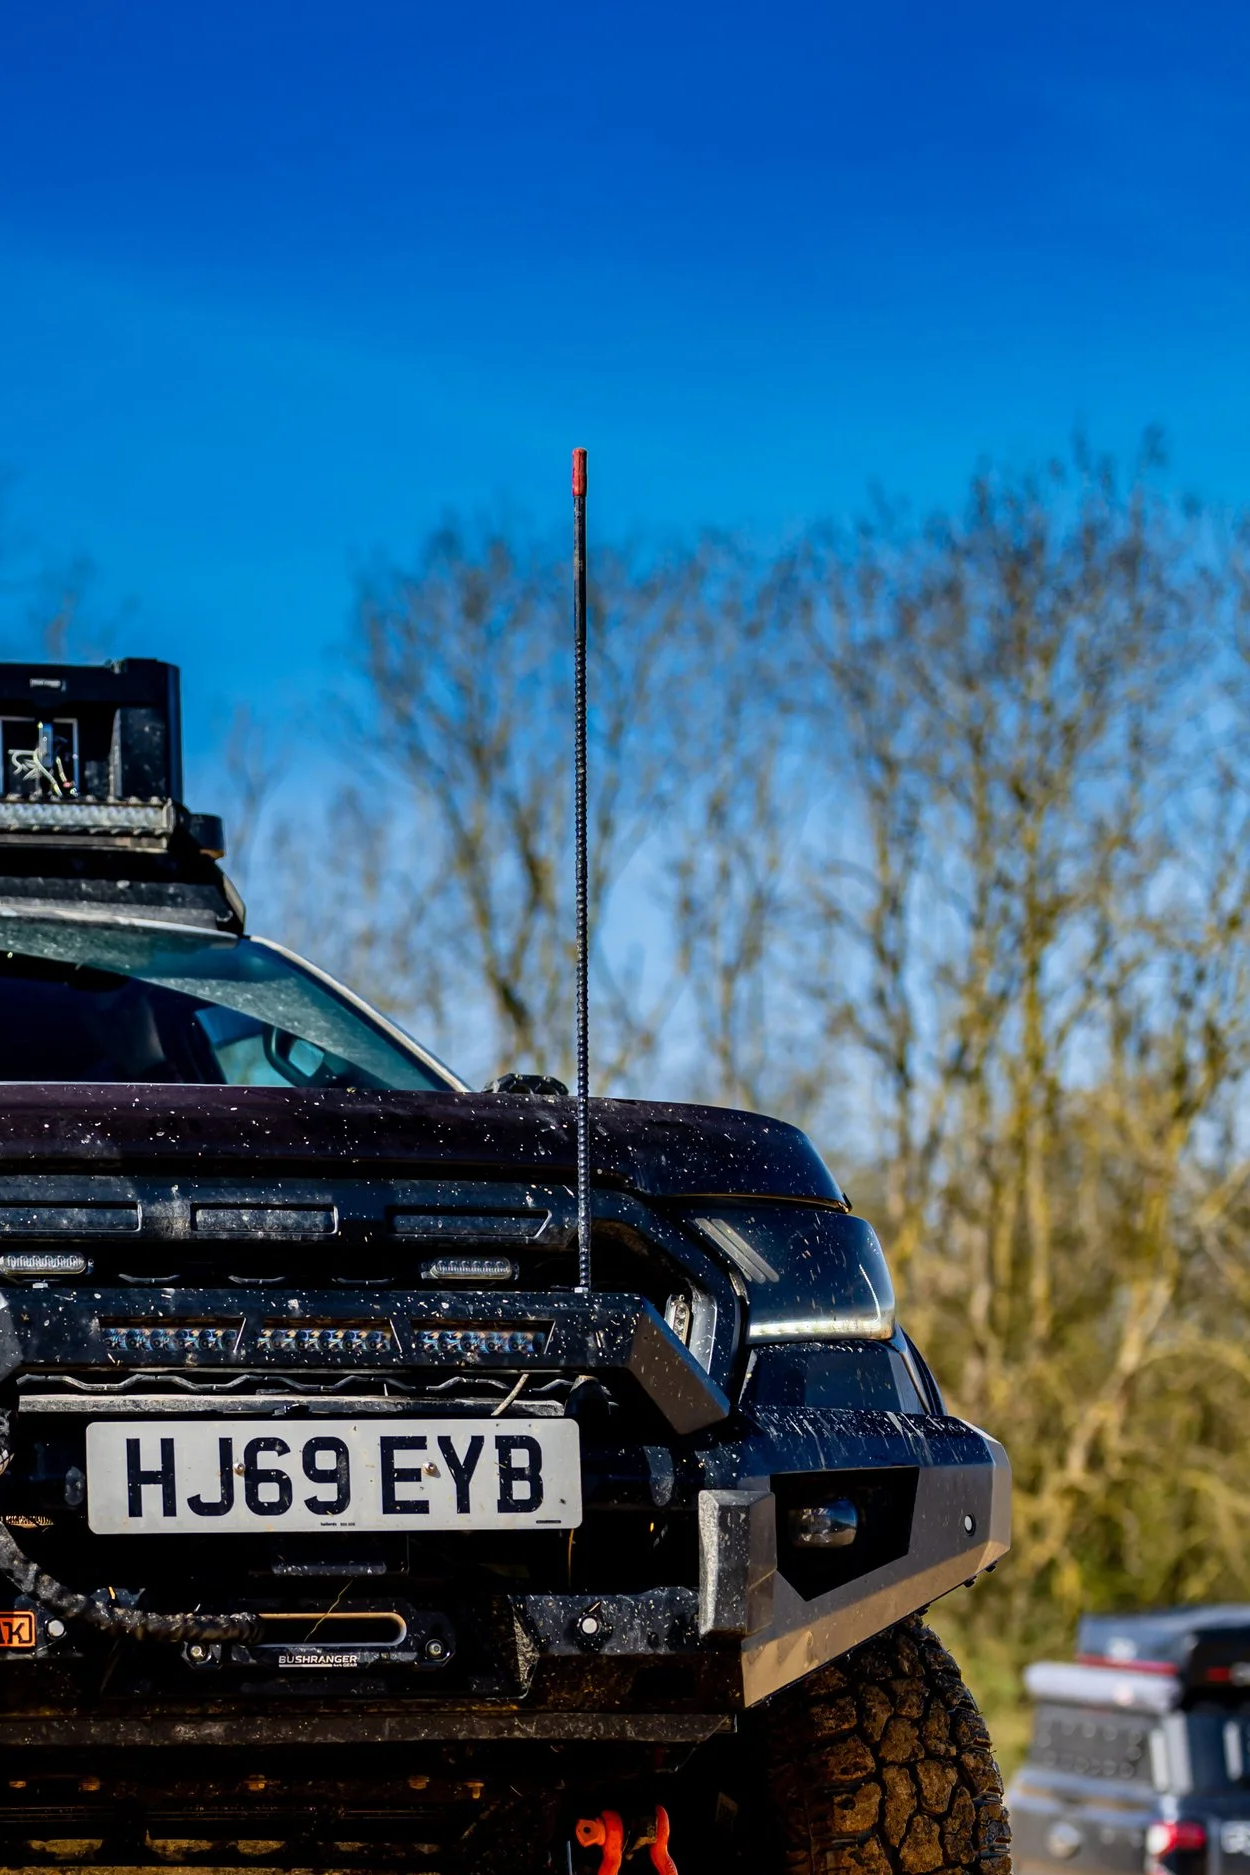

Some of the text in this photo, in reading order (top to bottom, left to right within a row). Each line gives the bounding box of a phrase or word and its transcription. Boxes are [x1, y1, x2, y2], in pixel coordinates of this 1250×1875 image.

[125, 1434, 545, 1518] HJ69 EYB
[278, 1654, 358, 1665] BUSHRANGER
